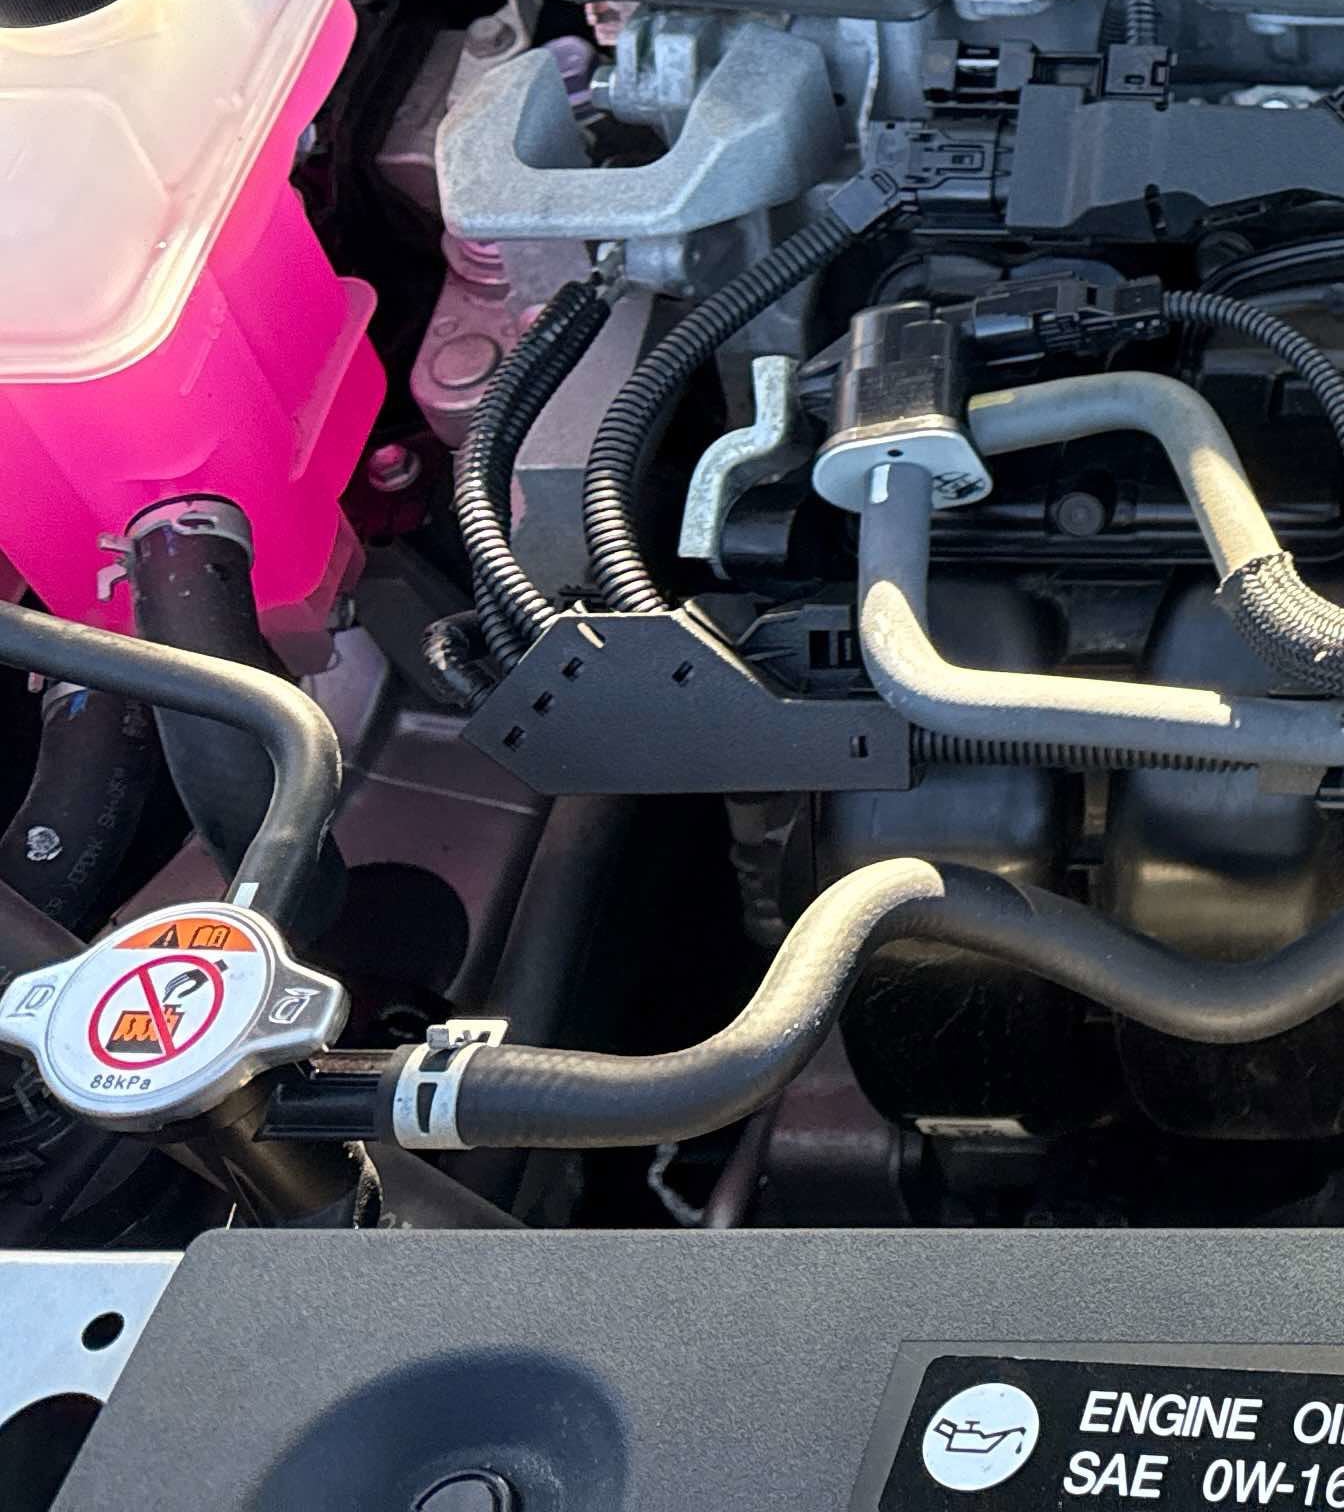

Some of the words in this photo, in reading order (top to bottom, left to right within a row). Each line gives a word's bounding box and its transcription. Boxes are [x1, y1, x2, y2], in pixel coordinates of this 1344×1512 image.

[90, 1074, 152, 1090] 88kPa
[1079, 1390, 1263, 1441] ENGINE
[1062, 1451, 1169, 1498] SAE
